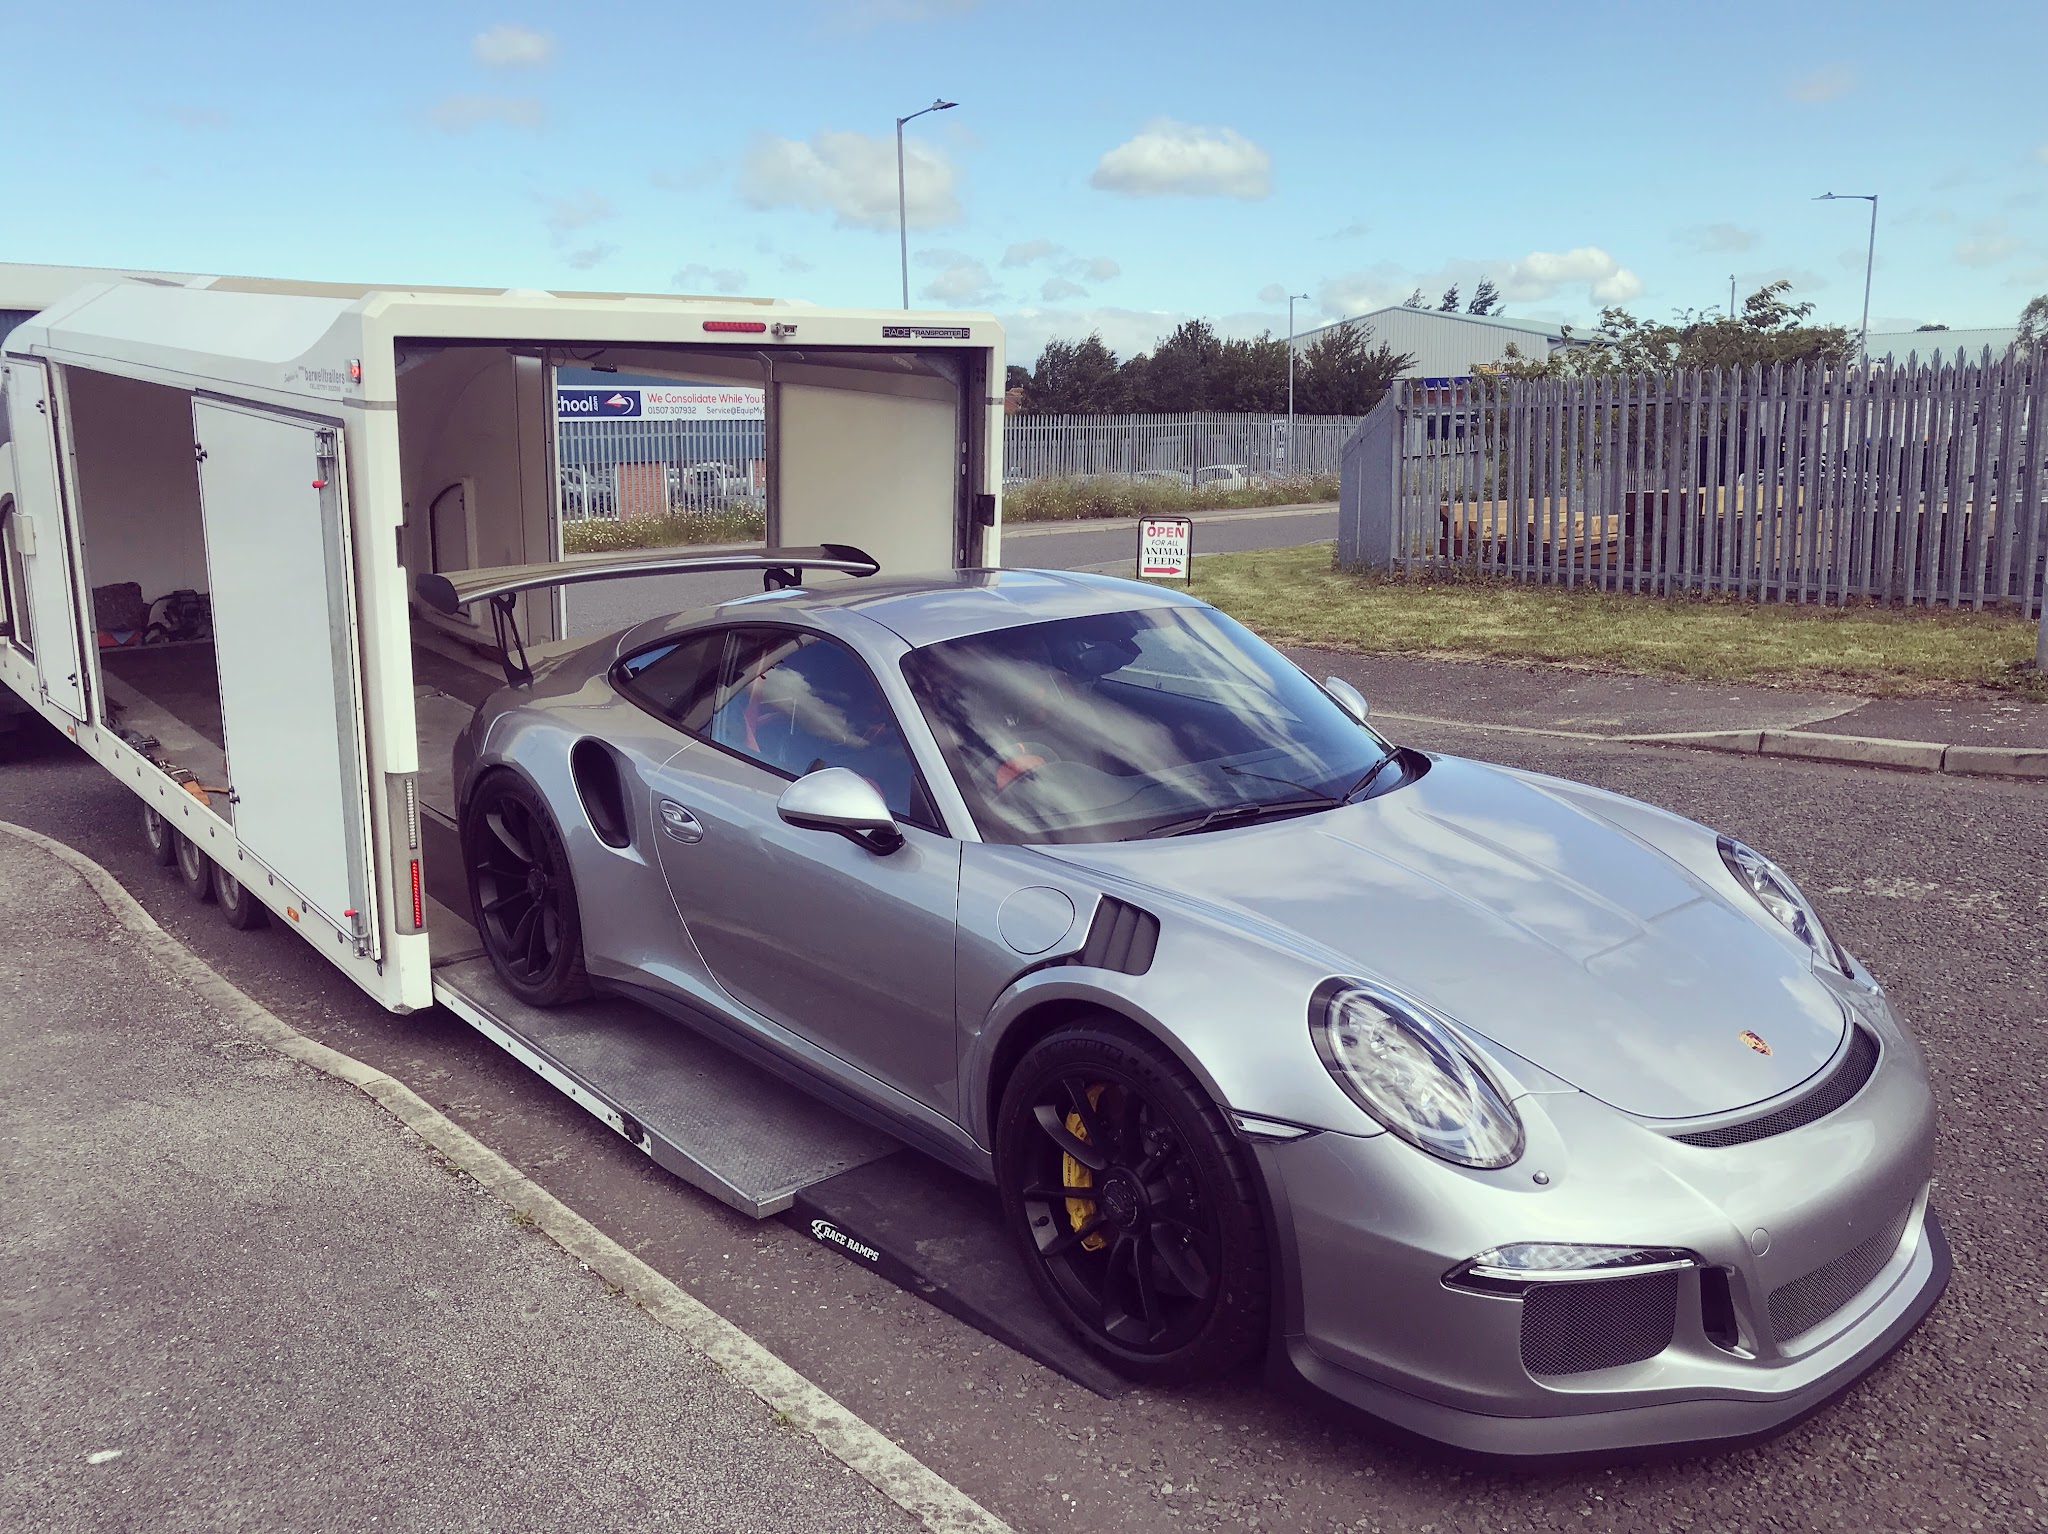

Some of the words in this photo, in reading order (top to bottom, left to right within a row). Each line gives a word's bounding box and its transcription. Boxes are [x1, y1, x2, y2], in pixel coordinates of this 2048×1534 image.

[883, 328, 909, 338] RACE
[647, 392, 663, 404] We
[664, 393, 717, 404] Consolidate
[718, 393, 743, 404] While
[744, 394, 760, 404] You
[647, 406, 669, 415] 01507
[669, 406, 697, 415] 307932
[1147, 526, 1184, 538] OPEN
[1144, 547, 1185, 556] ANIMAL
[1147, 557, 1182, 565] FEEDS
[823, 1226, 847, 1245] RACE
[846, 1238, 879, 1261] RAMPS
